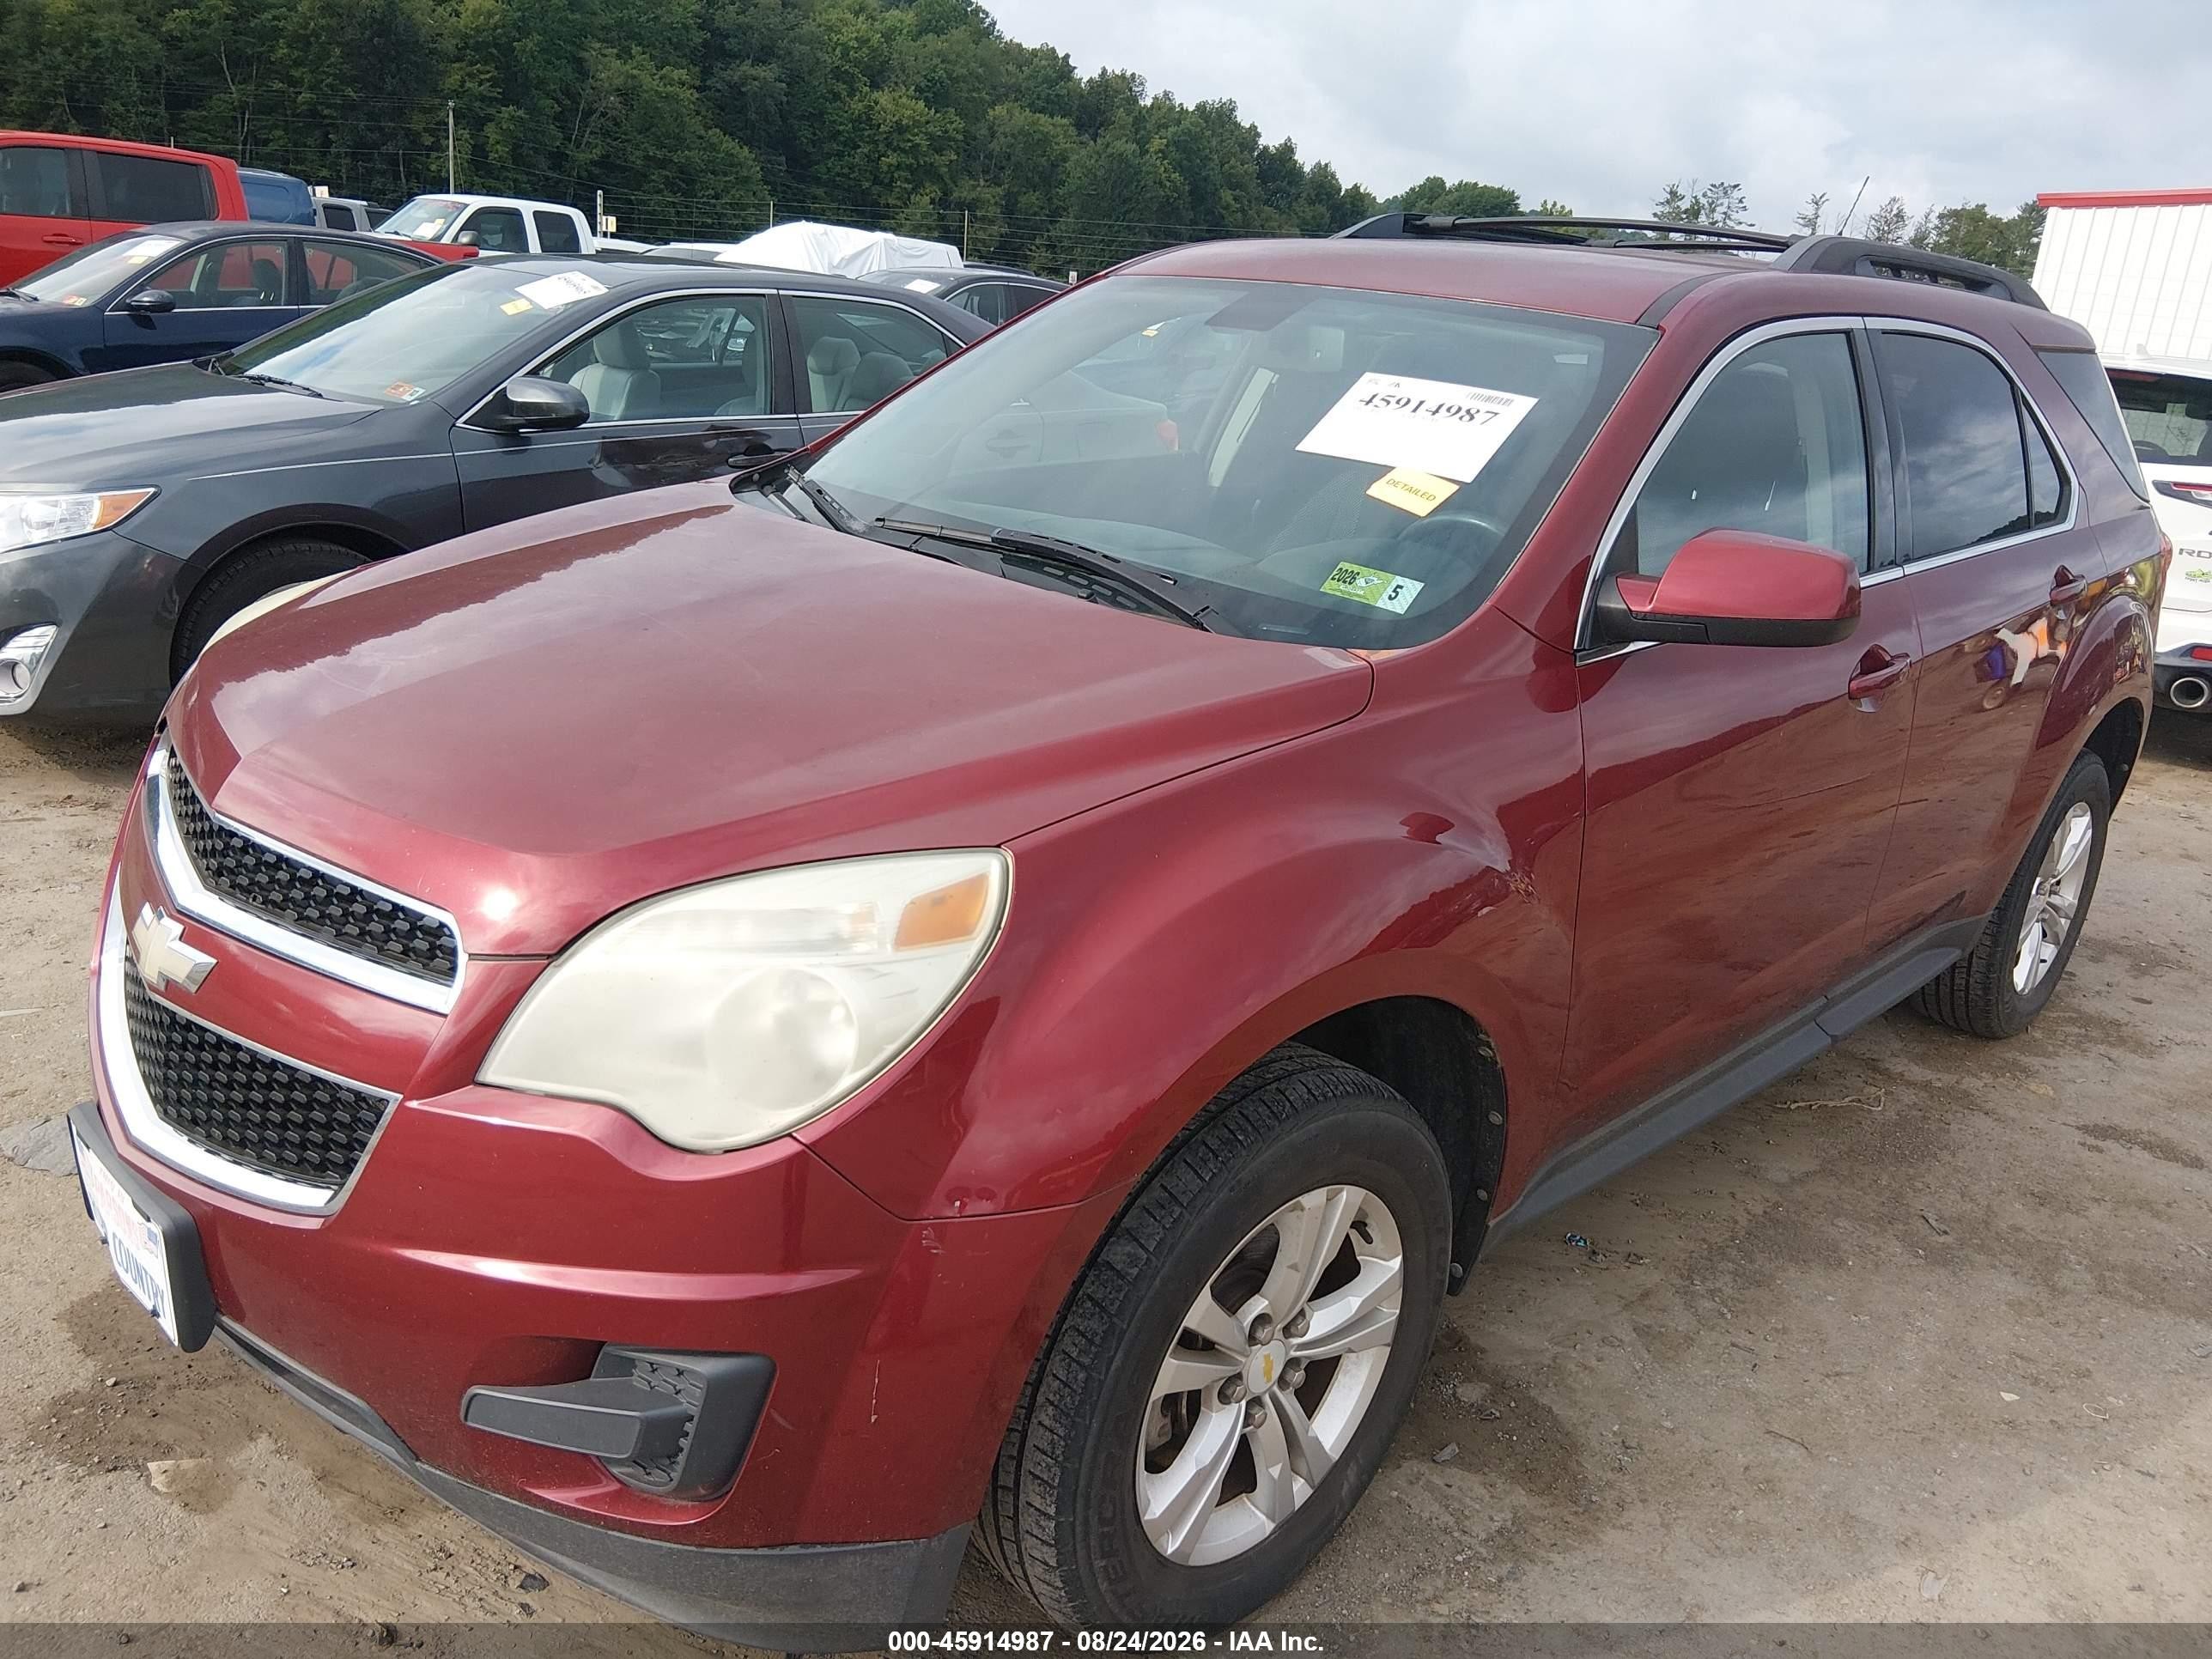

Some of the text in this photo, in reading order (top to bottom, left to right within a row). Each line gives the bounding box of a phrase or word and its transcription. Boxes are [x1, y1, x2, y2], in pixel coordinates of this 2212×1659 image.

[1358, 392, 1501, 426] 45914987
[1386, 477, 1437, 501] DETAILED
[1330, 567, 1360, 586] 2026
[1388, 584, 1404, 601] 5
[112, 1231, 165, 1320] COUNTRY
